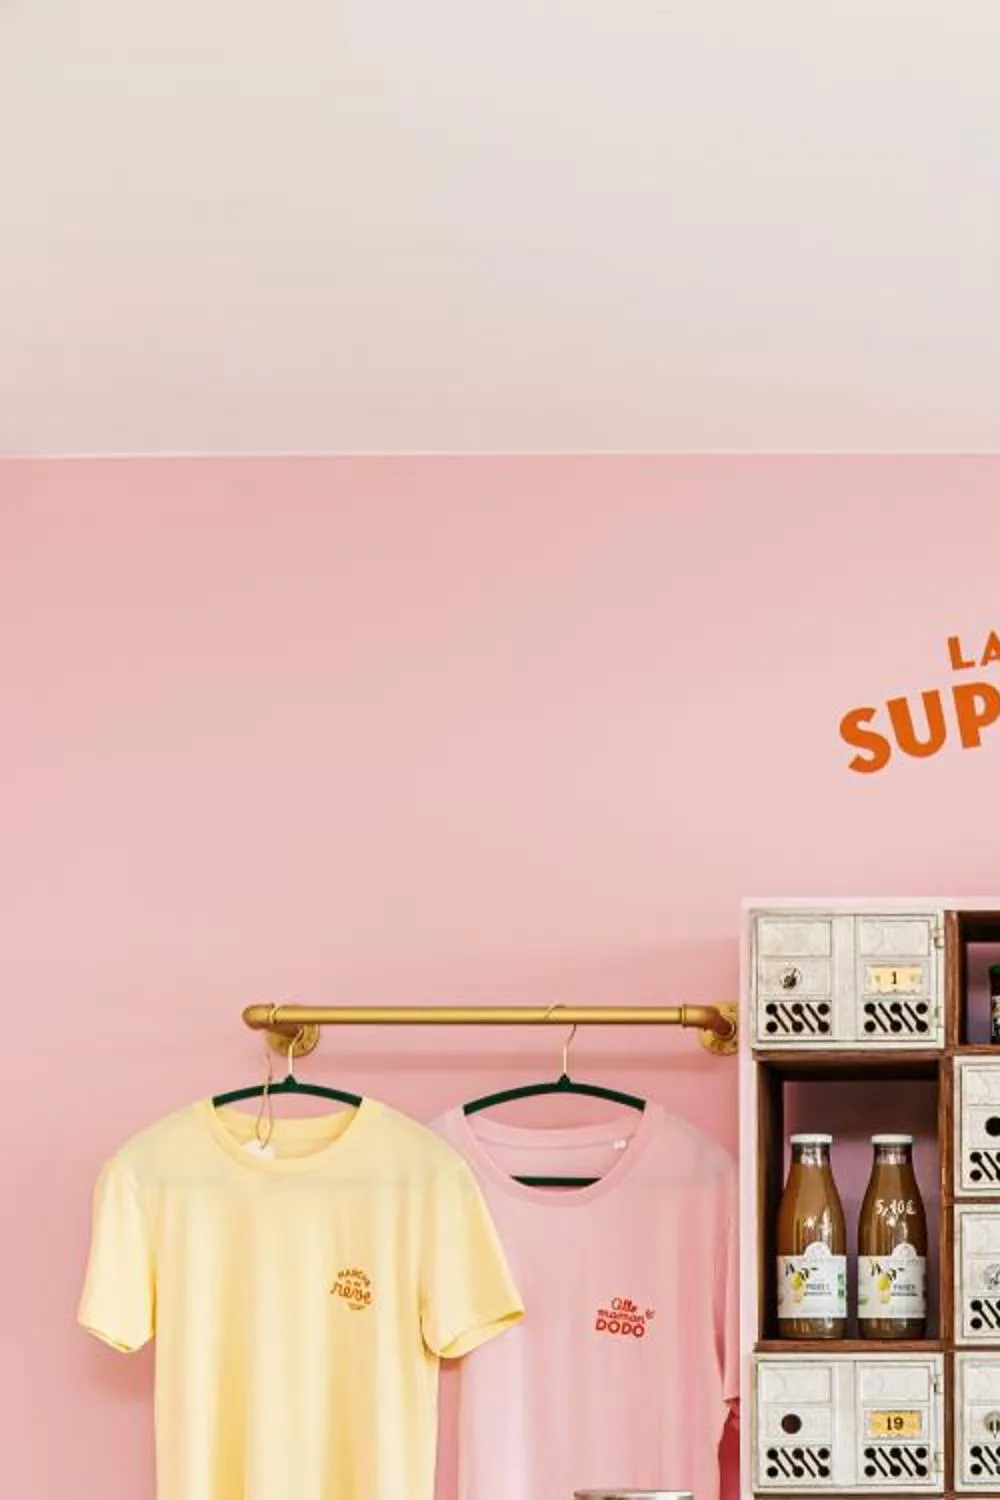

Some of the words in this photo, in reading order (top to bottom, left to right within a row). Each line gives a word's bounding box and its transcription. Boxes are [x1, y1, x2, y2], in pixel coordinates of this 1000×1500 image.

[891, 971, 898, 985] 1
[596, 1319, 645, 1338] DODO
[886, 1416, 905, 1431] 19
